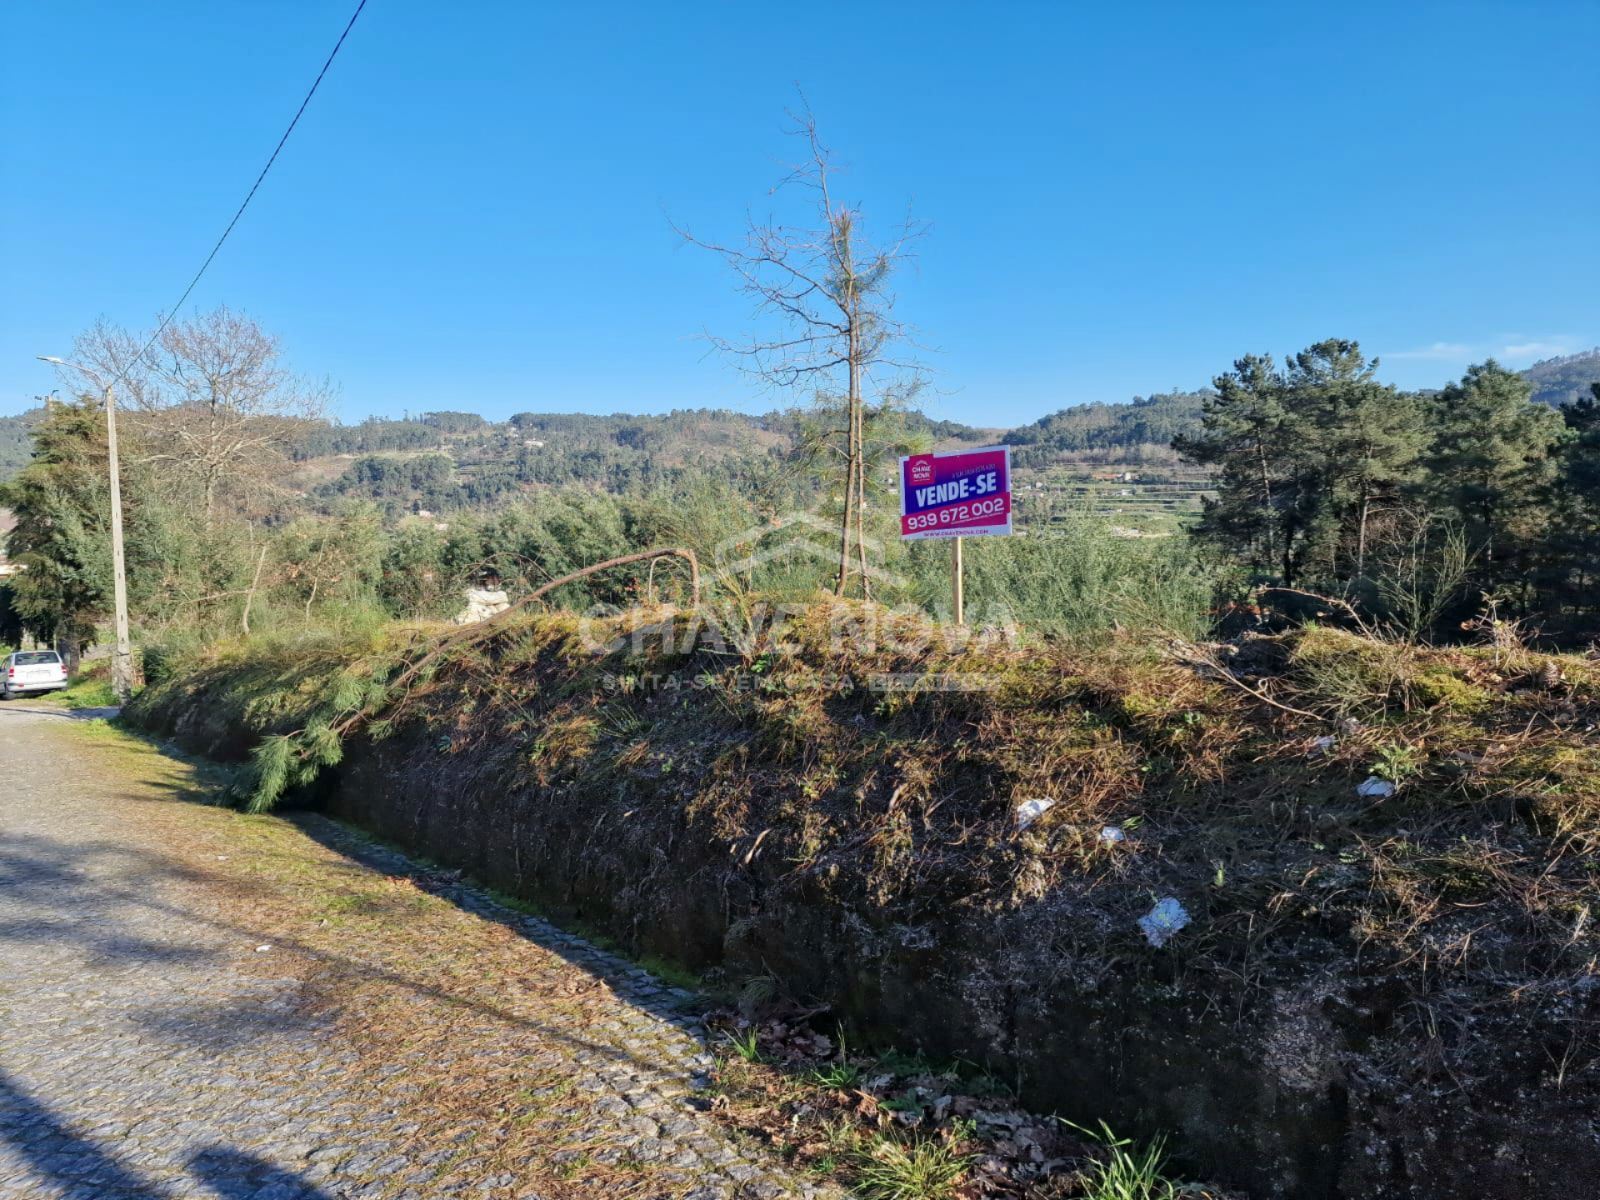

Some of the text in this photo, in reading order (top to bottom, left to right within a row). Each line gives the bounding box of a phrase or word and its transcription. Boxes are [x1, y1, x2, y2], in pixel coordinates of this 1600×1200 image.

[916, 472, 997, 508] VENDE-SE
[908, 498, 1004, 530] 939 672 002
